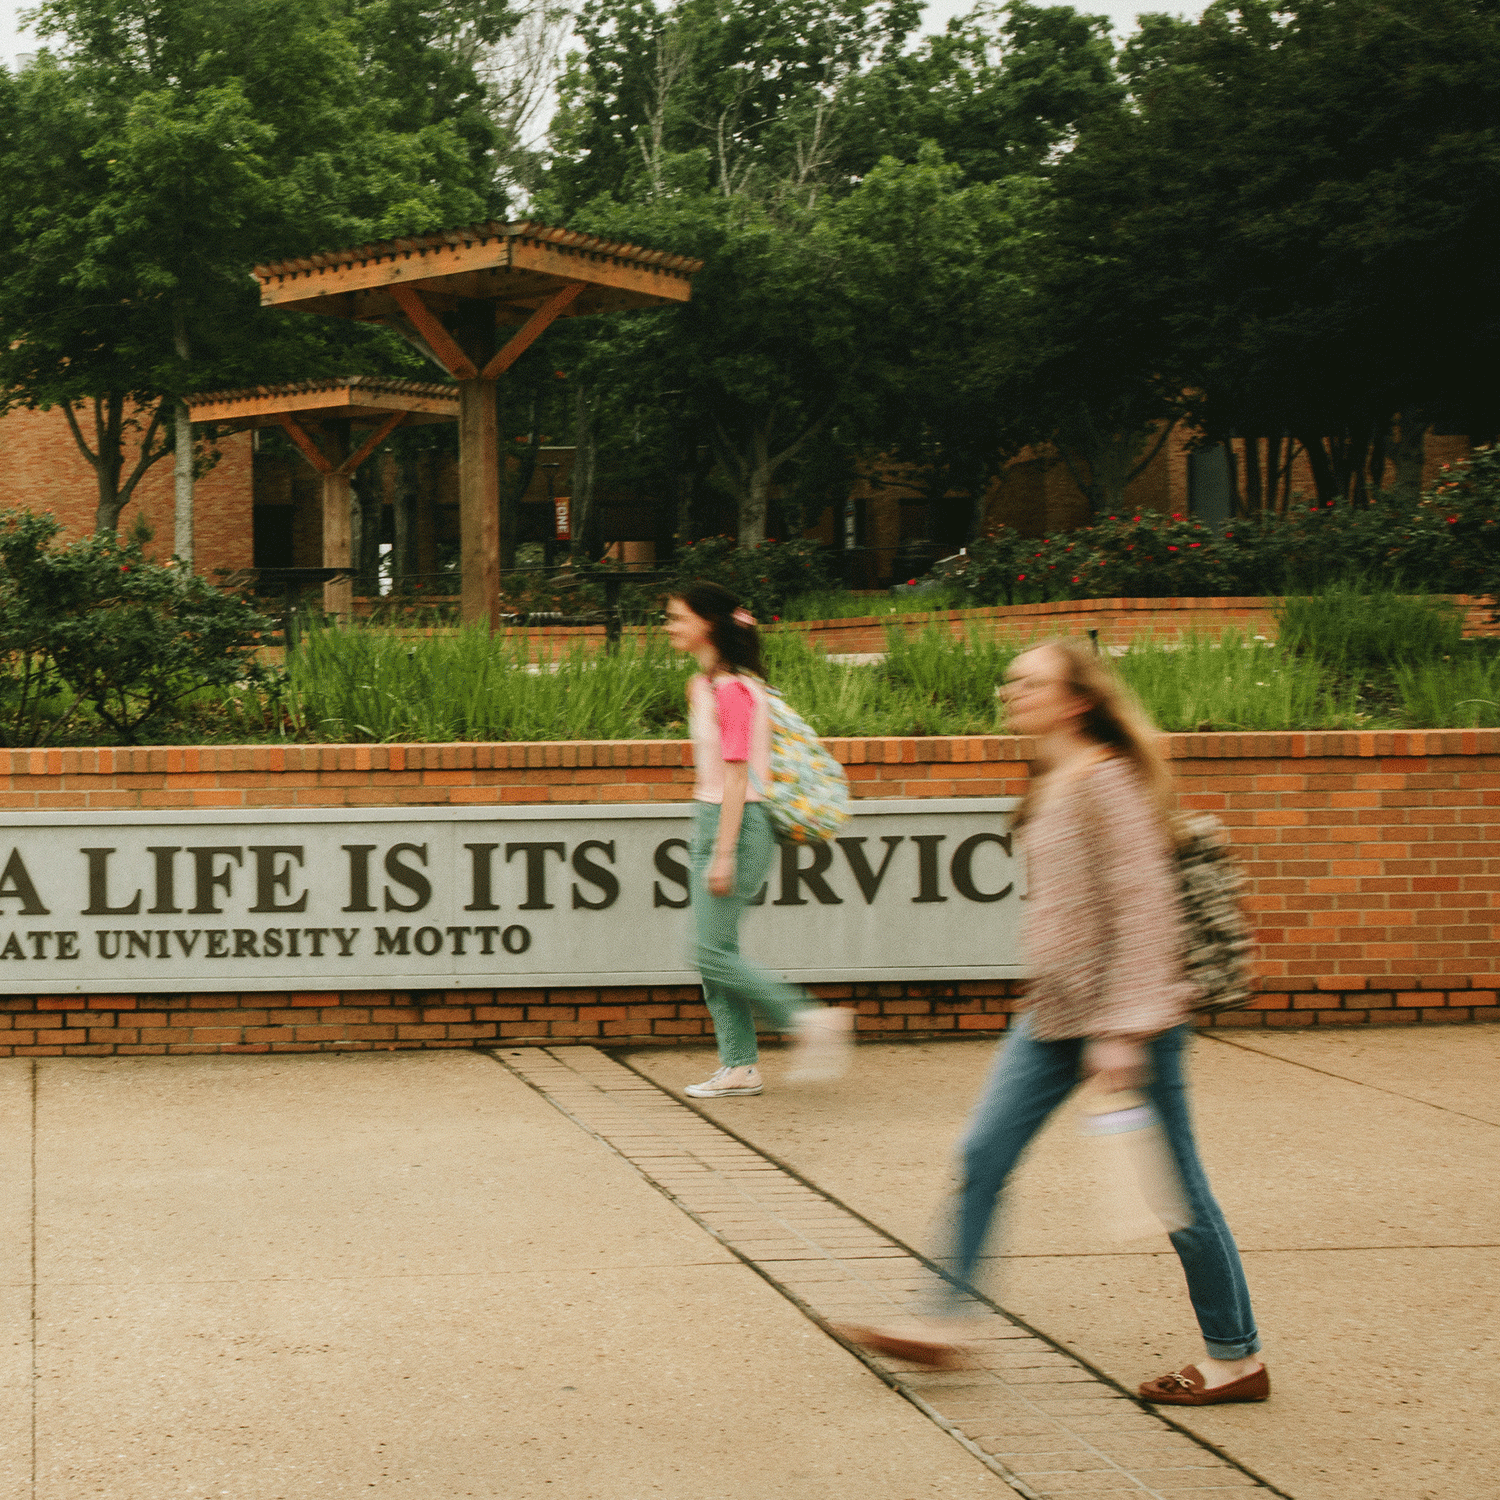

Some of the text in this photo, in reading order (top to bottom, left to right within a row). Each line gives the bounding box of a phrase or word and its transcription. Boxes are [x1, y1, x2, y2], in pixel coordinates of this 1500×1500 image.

[79, 845, 309, 916] LIFE
[341, 842, 433, 914] IS
[463, 840, 621, 912] ITS
[652, 832, 1030, 910] SRVIC
[95, 927, 360, 960] UNIVERSITY
[374, 924, 532, 957] MOTTO
